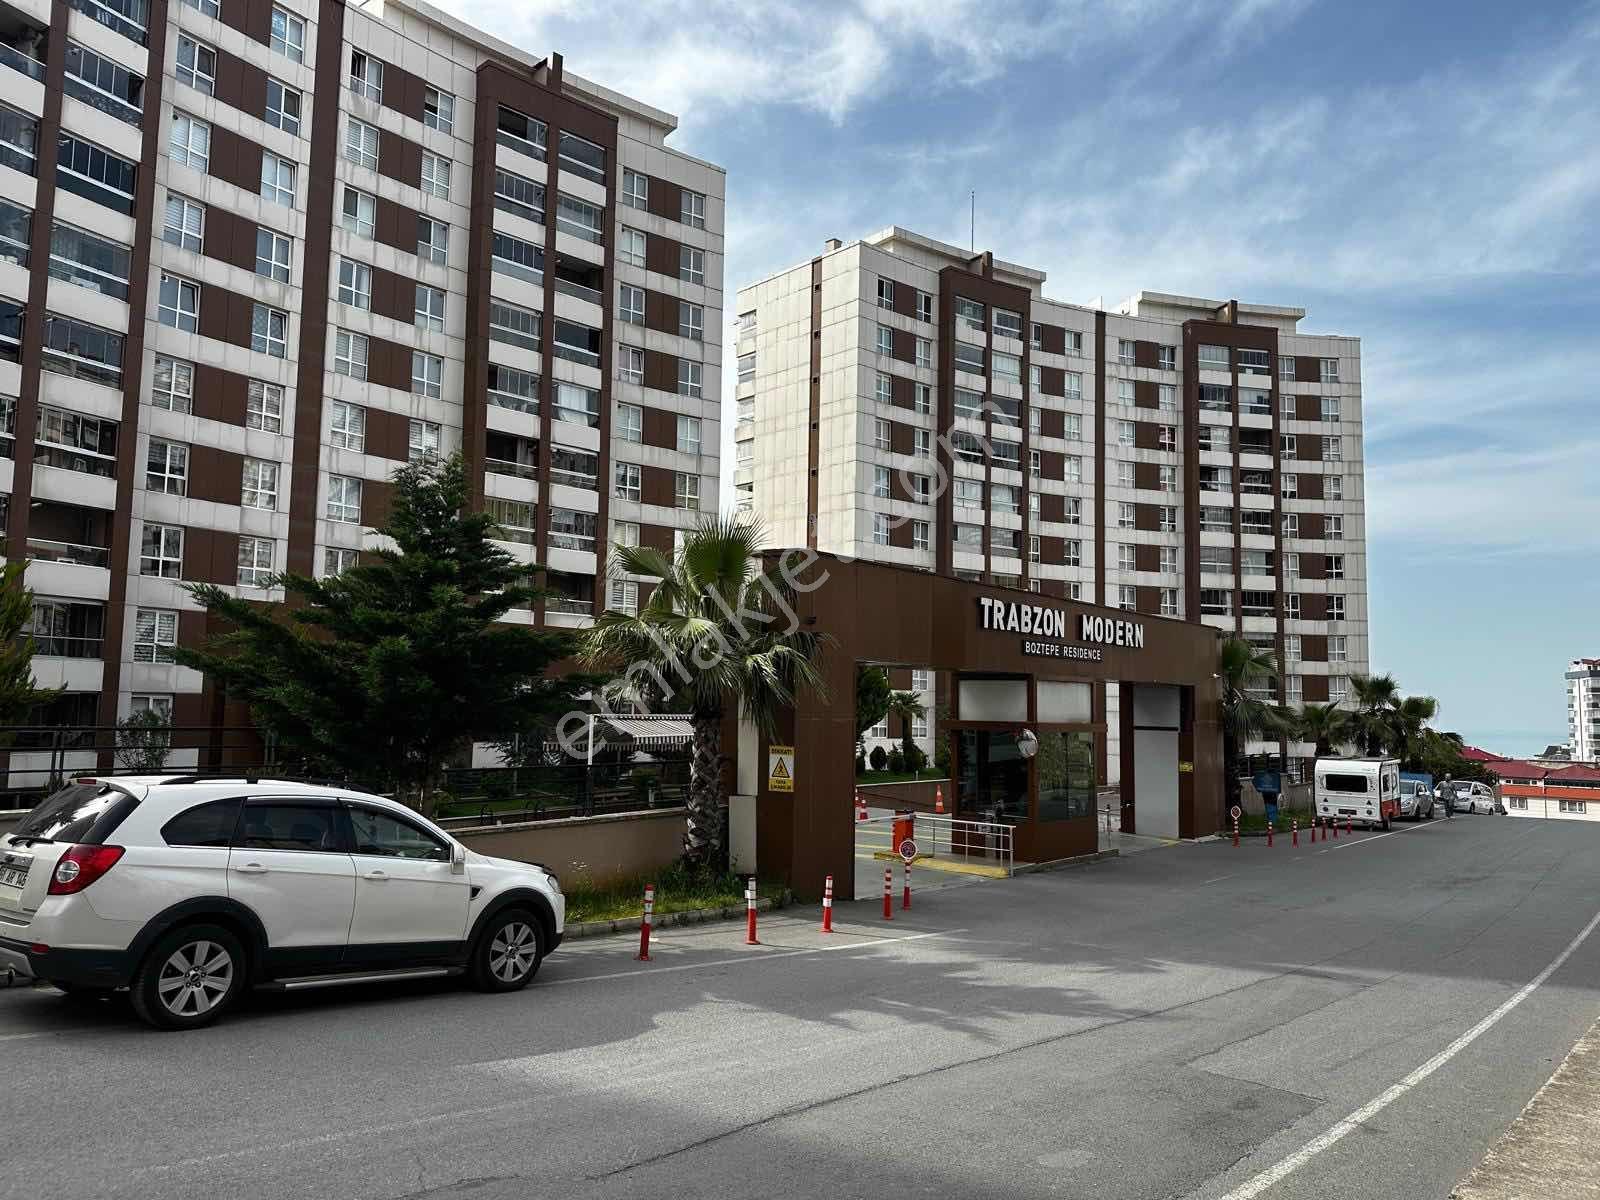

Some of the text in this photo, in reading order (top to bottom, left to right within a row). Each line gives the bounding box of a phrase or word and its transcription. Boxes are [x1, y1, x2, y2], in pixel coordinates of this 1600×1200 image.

[981, 597, 1144, 648] TRABZON MODERN
[1025, 642, 1101, 661] BOZTEPE RESIDENCE
